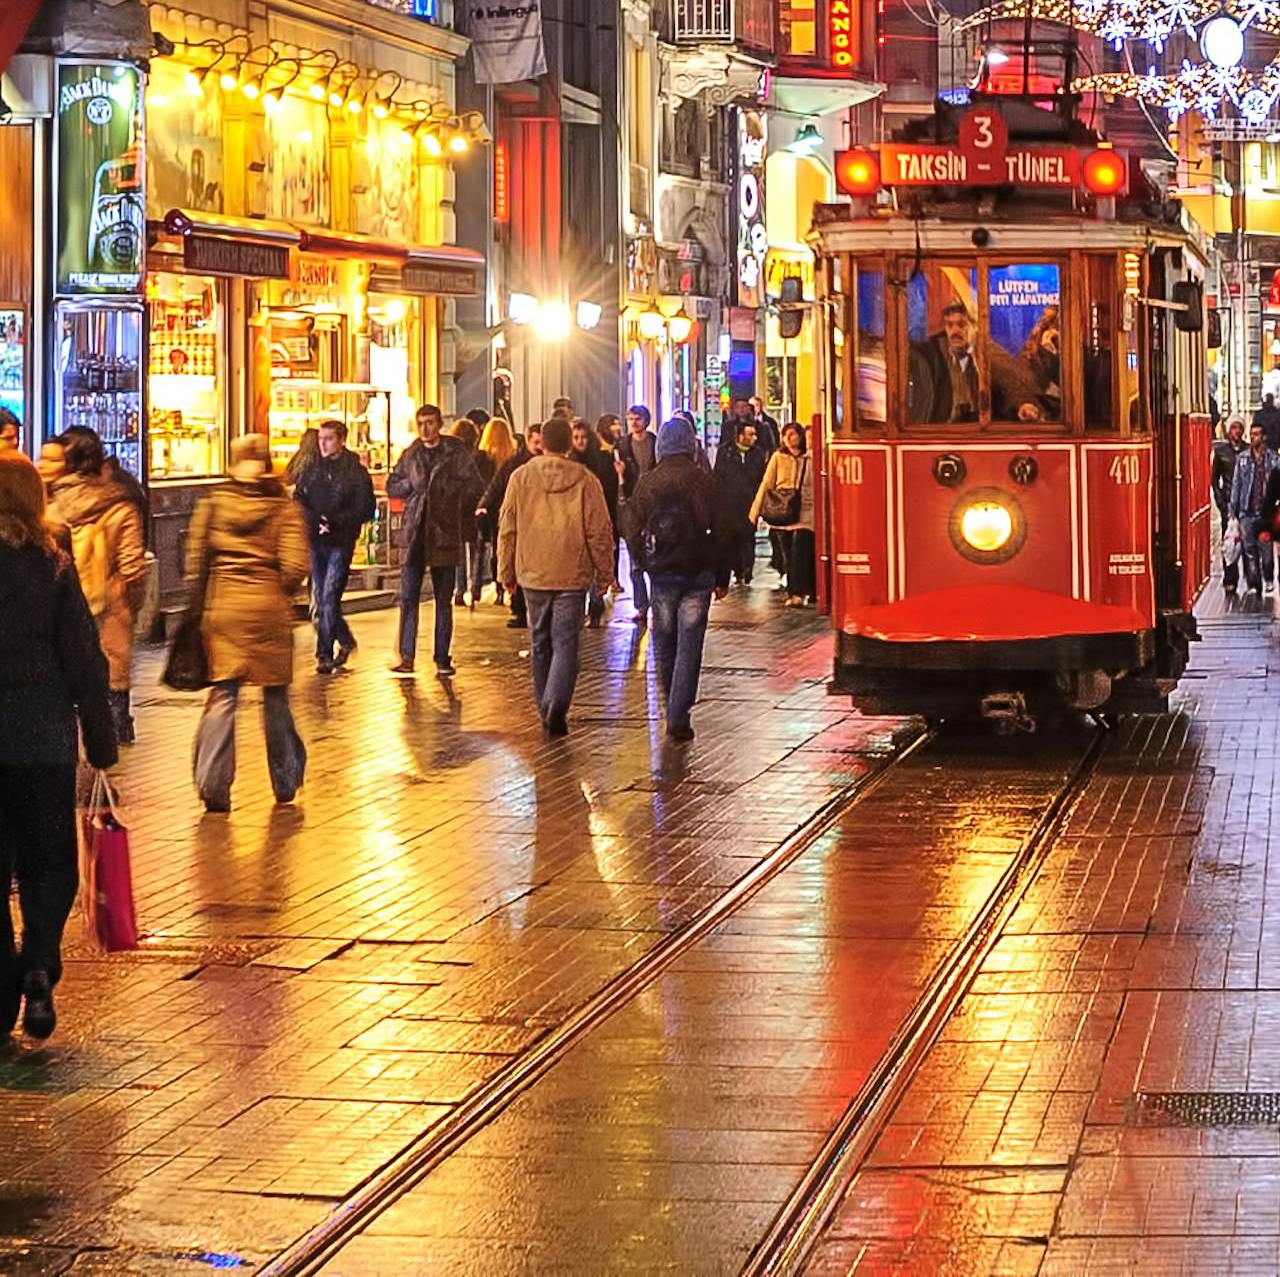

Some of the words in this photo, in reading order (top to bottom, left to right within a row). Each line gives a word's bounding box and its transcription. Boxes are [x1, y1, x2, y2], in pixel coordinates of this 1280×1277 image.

[973, 116, 993, 148] 3
[1005, 153, 1071, 183] TÜNEL
[1109, 455, 1139, 484] 410
